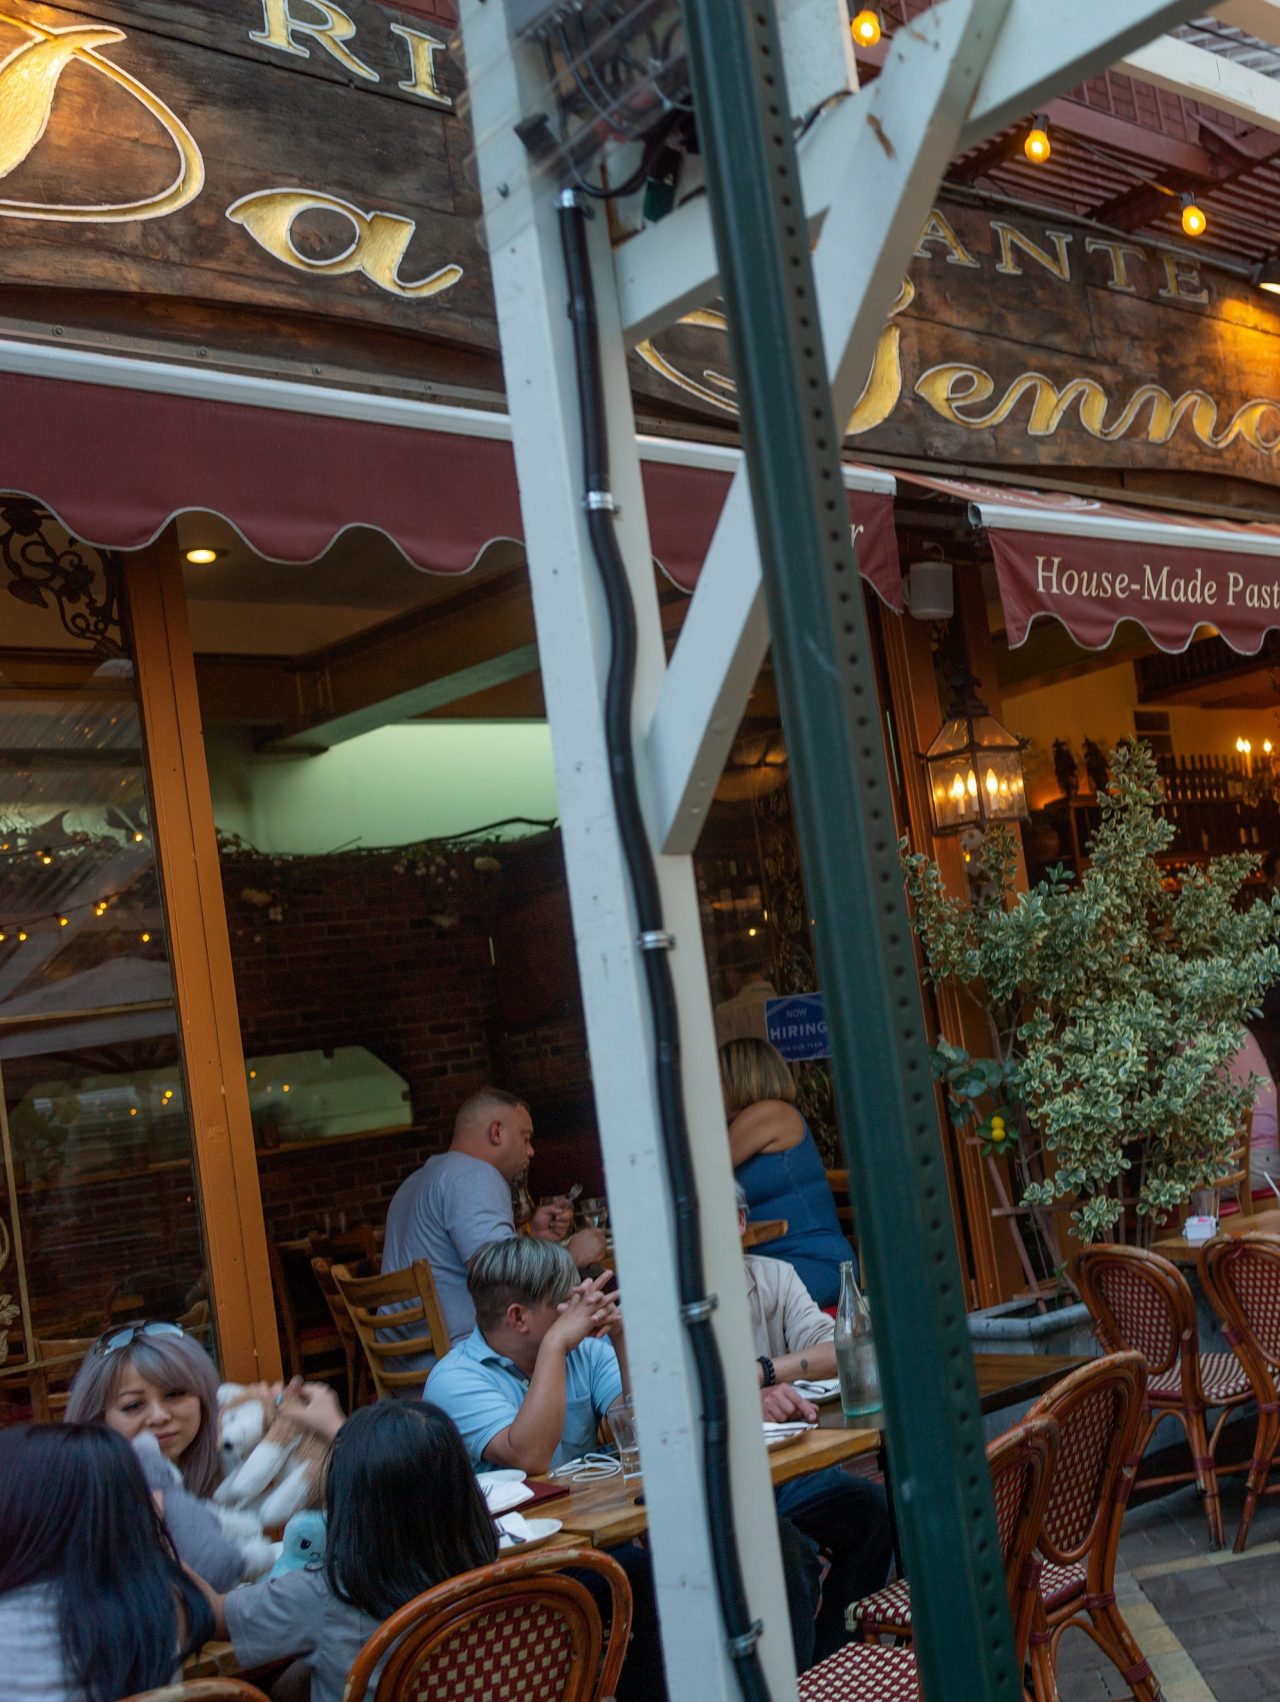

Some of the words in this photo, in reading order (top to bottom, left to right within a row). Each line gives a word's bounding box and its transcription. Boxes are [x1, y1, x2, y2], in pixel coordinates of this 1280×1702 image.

[1035, 555, 1217, 604] House-Made
[786, 1007, 808, 1019] NOW
[770, 1020, 828, 1041] HIRING
